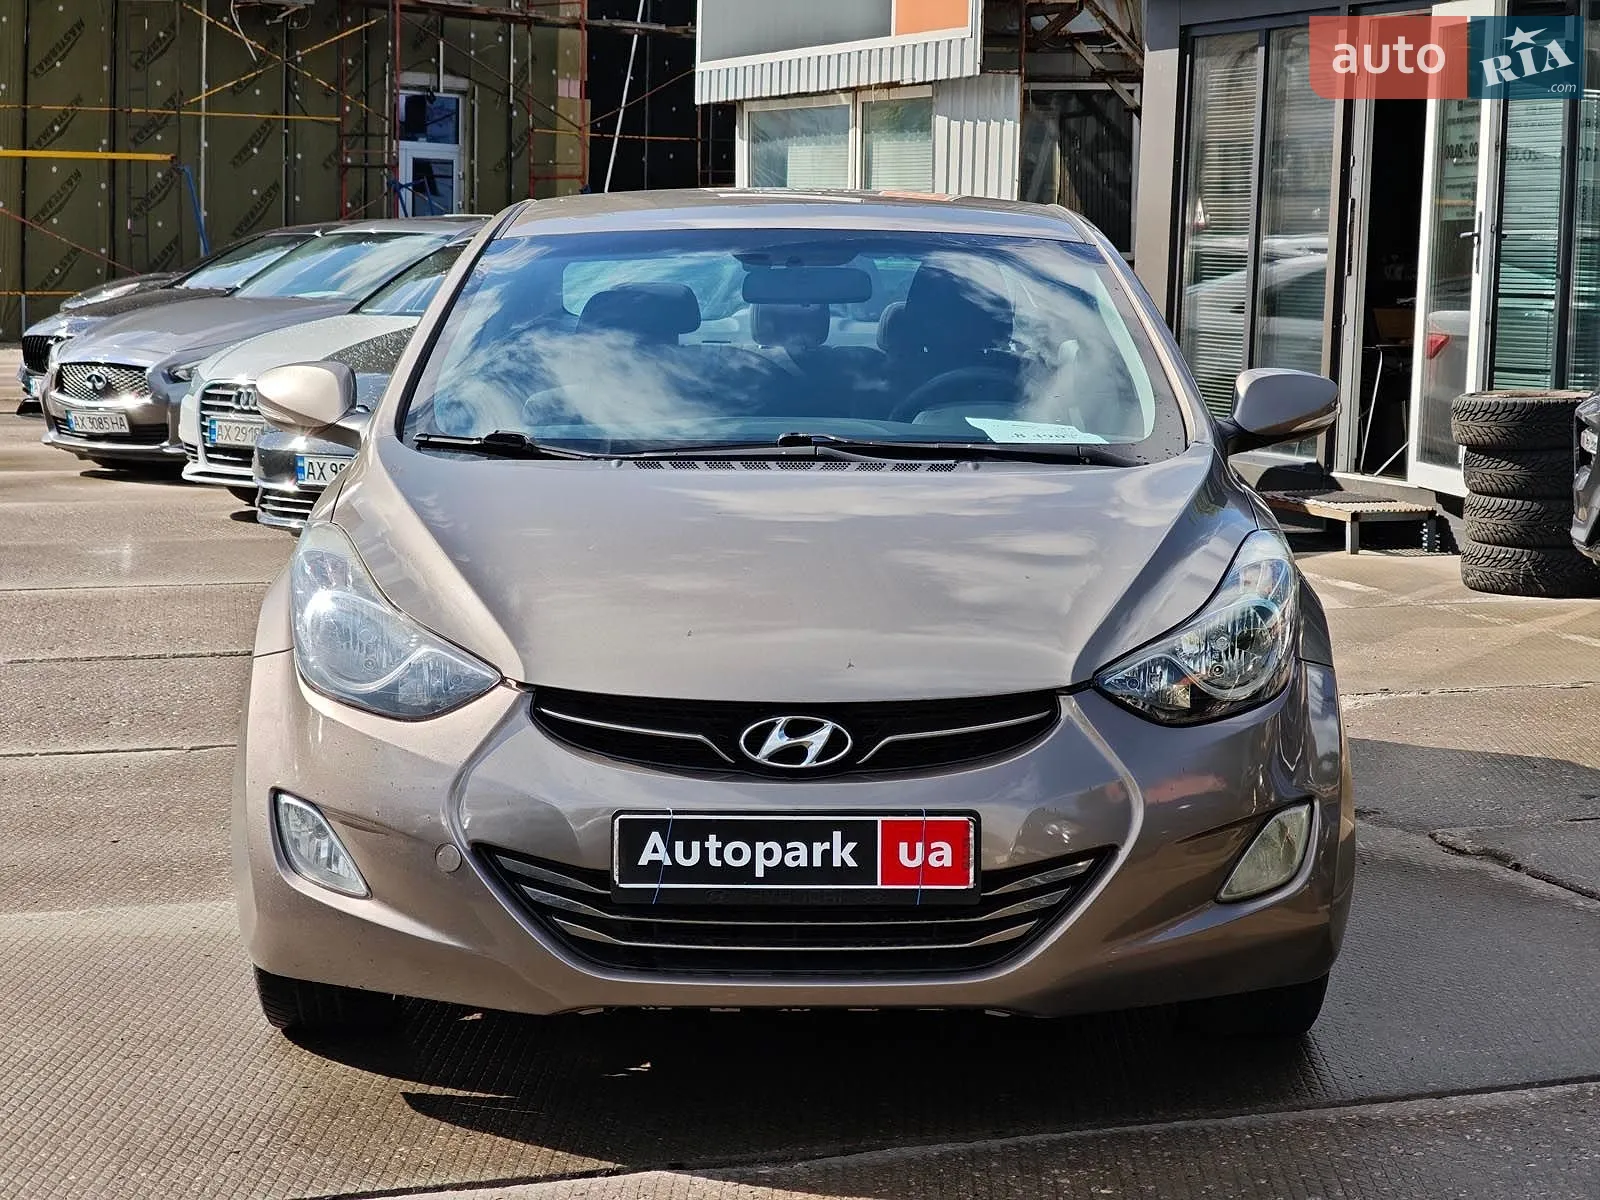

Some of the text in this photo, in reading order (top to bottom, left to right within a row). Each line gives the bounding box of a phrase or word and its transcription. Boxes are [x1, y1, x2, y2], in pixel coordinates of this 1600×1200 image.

[217, 424, 232, 441] AX
[307, 461, 327, 481] AX
[637, 830, 953, 877] Autopark ua
